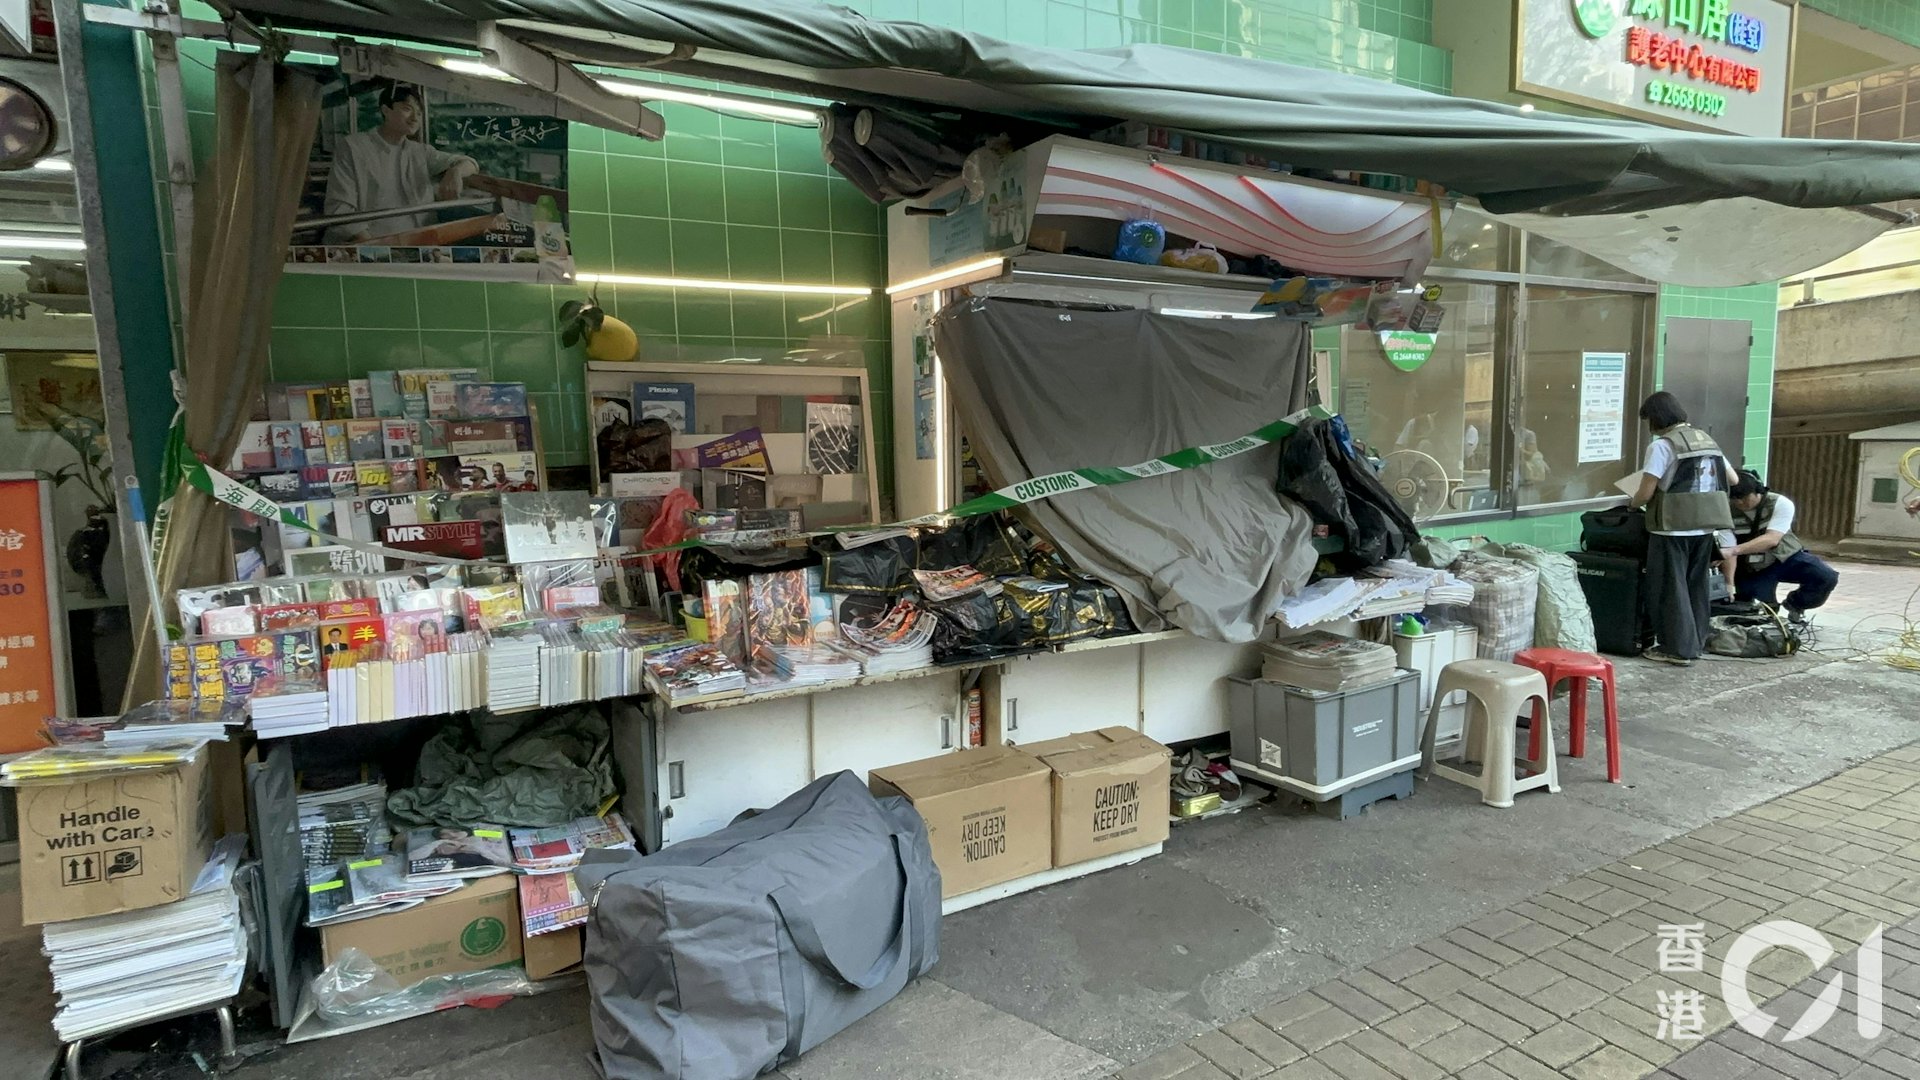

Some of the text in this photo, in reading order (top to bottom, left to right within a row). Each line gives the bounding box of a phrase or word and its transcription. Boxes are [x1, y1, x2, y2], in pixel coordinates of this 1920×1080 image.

[1627, 26, 1760, 94] 護老中心有限公司
[1663, 82, 1726, 116] 2668 0302
[1211, 436, 1256, 459] CUSTOMS
[1014, 472, 1079, 500] CUSTOMS
[217, 483, 278, 518] 海關
[352, 624, 378, 642] 羊
[1095, 780, 1140, 809] CAUTION:
[59, 805, 141, 829] Handle
[961, 815, 1006, 843] KEEP DRY
[1093, 802, 1140, 832] KEEP DRY
[46, 830, 95, 851] with
[963, 835, 1006, 863] CAUTION:
